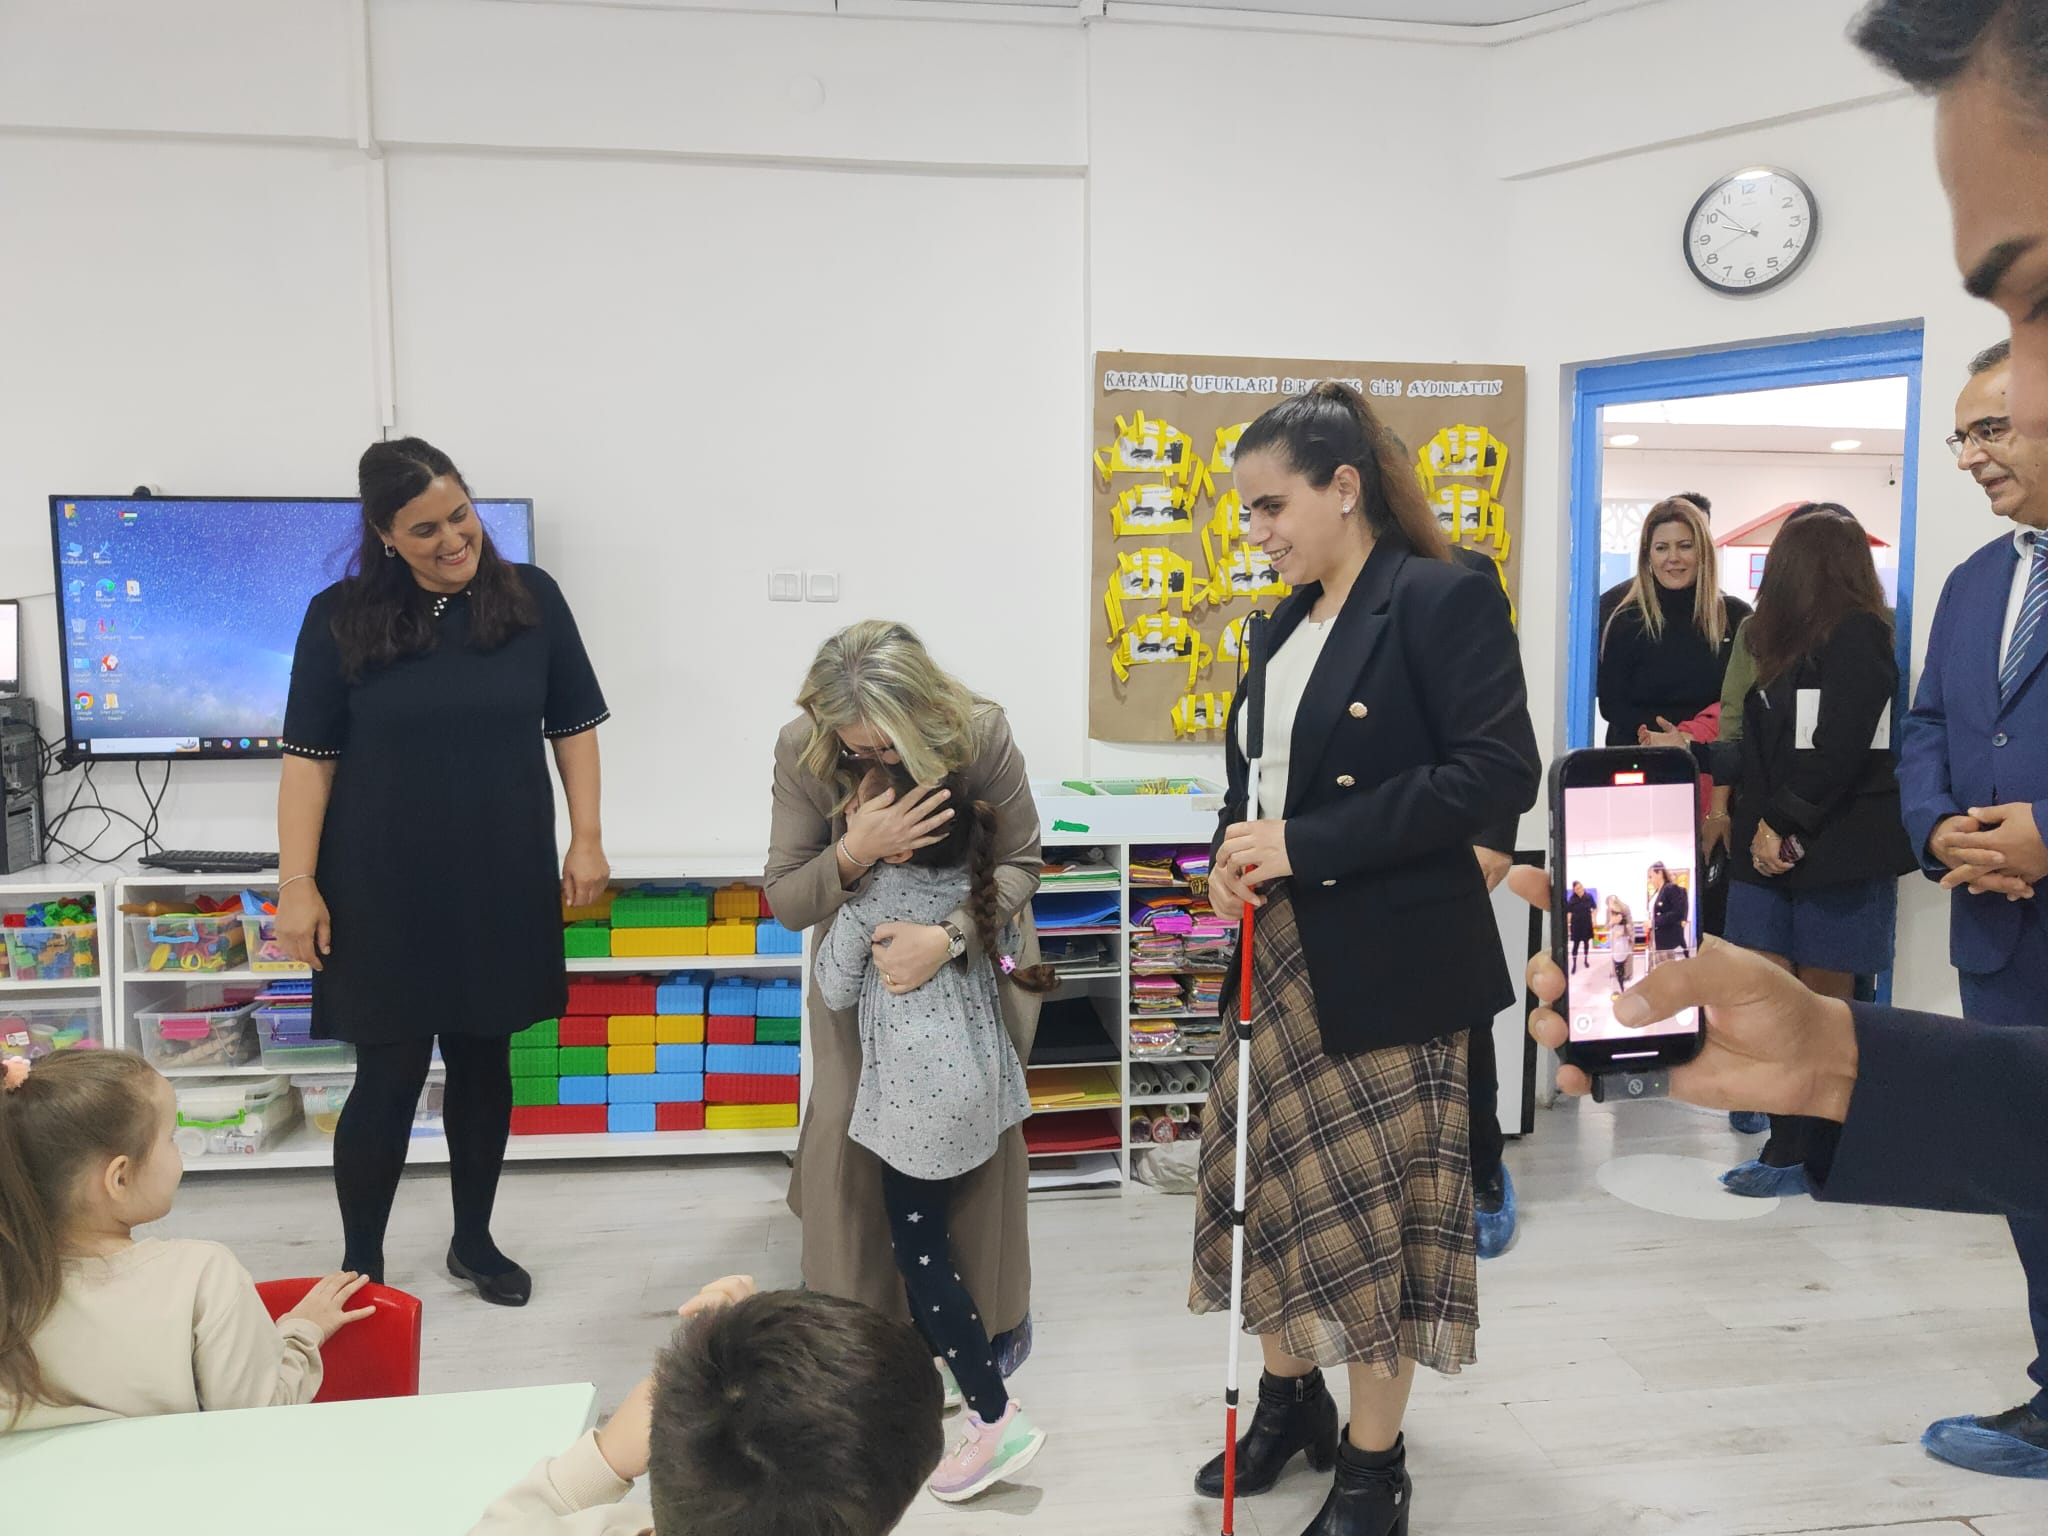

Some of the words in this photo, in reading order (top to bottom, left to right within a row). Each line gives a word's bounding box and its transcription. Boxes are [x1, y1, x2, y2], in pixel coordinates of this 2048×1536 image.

[1741, 183, 1757, 195] 12
[1722, 193, 1732, 206] 11
[1781, 196, 1793, 209] 2
[1706, 212, 1718, 224] 10
[1789, 215, 1802, 227] 3
[1699, 234, 1711, 245] 9
[1782, 238, 1794, 249] 4
[1706, 253, 1719, 265] 8
[1767, 256, 1779, 268] 5
[1722, 265, 1733, 277] 7
[1744, 267, 1756, 279] 6
[1105, 372, 1186, 390] KARANLIK
[1194, 376, 1274, 392] UFUKLARI
[1410, 381, 1500, 395] AYDINLATTIN
